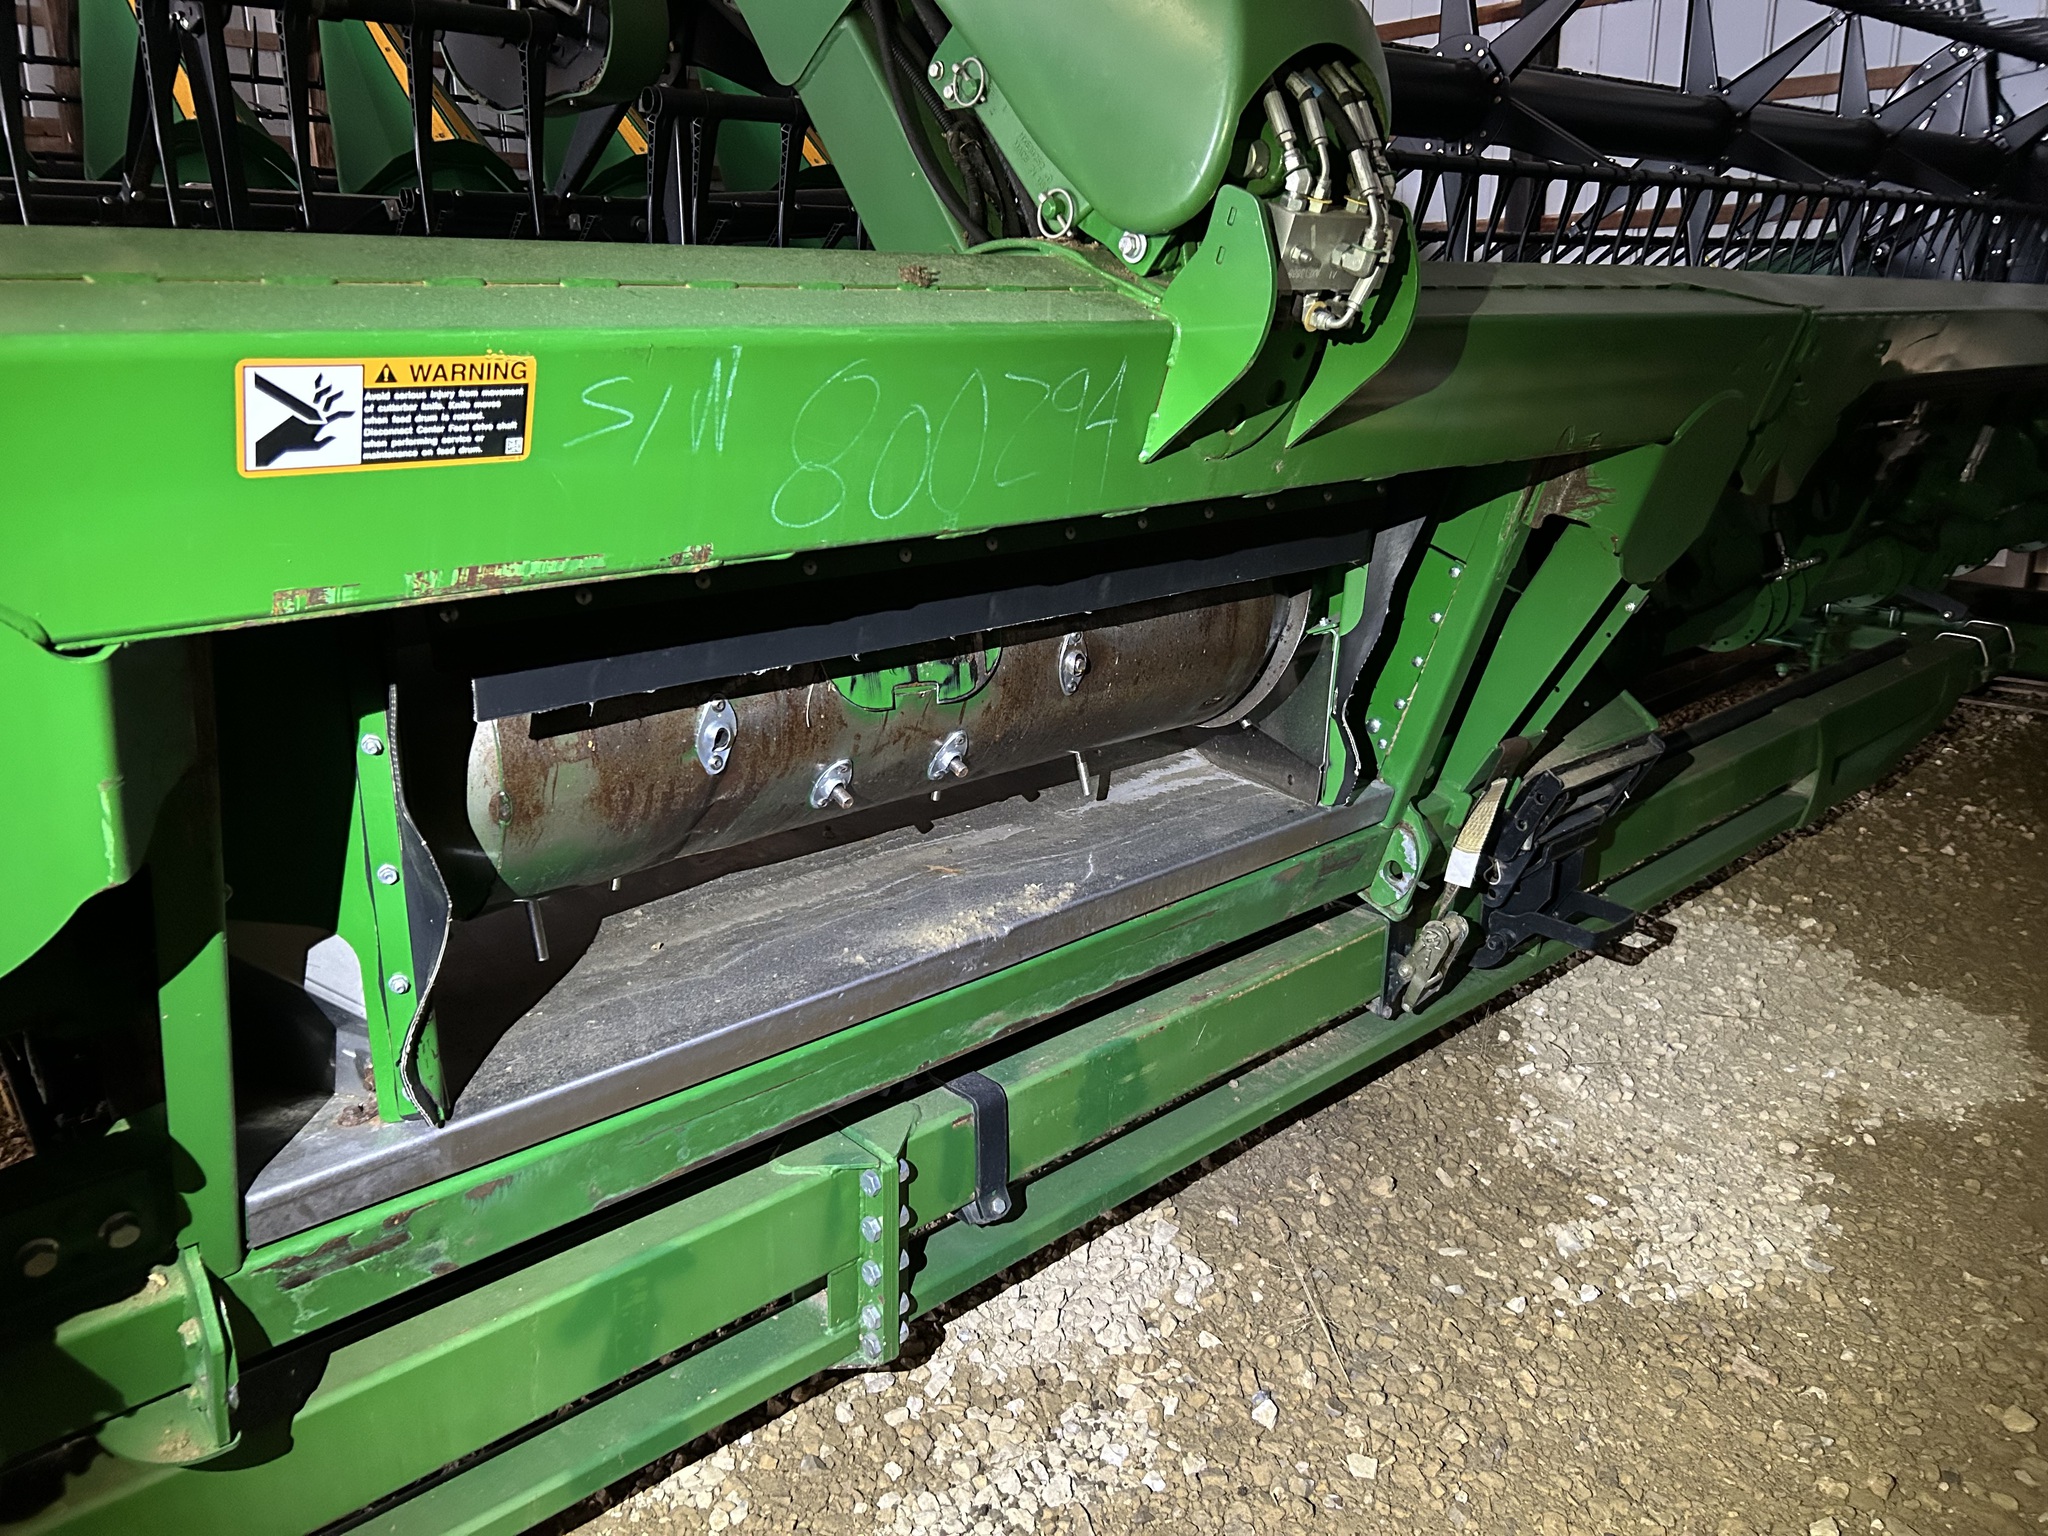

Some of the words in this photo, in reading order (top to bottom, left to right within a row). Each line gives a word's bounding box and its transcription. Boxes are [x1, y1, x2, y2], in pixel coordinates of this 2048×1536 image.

[409, 361, 527, 382] WARNING
[364, 391, 391, 401] Avoid
[393, 390, 427, 400] serious
[430, 389, 455, 400] injury
[458, 388, 479, 398] from
[481, 386, 524, 396] movement
[363, 403, 375, 413] of
[448, 400, 471, 410] Knife
[473, 400, 502, 409] moves
[363, 415, 389, 425] when
[391, 413, 412, 424] feed
[414, 413, 438, 423] drum
[441, 412, 450, 422] is
[363, 426, 413, 437] Disconnect
[416, 425, 445, 434] Center
[448, 423, 470, 433] Feed
[472, 422, 494, 432] drive
[496, 420, 518, 430] shaft
[362, 439, 388, 448] when
[390, 436, 438, 448] performing
[441, 434, 472, 444] service
[474, 434, 485, 443] or
[362, 450, 418, 460] maintenance
[420, 449, 434, 457] on
[436, 446, 456, 456] feed
